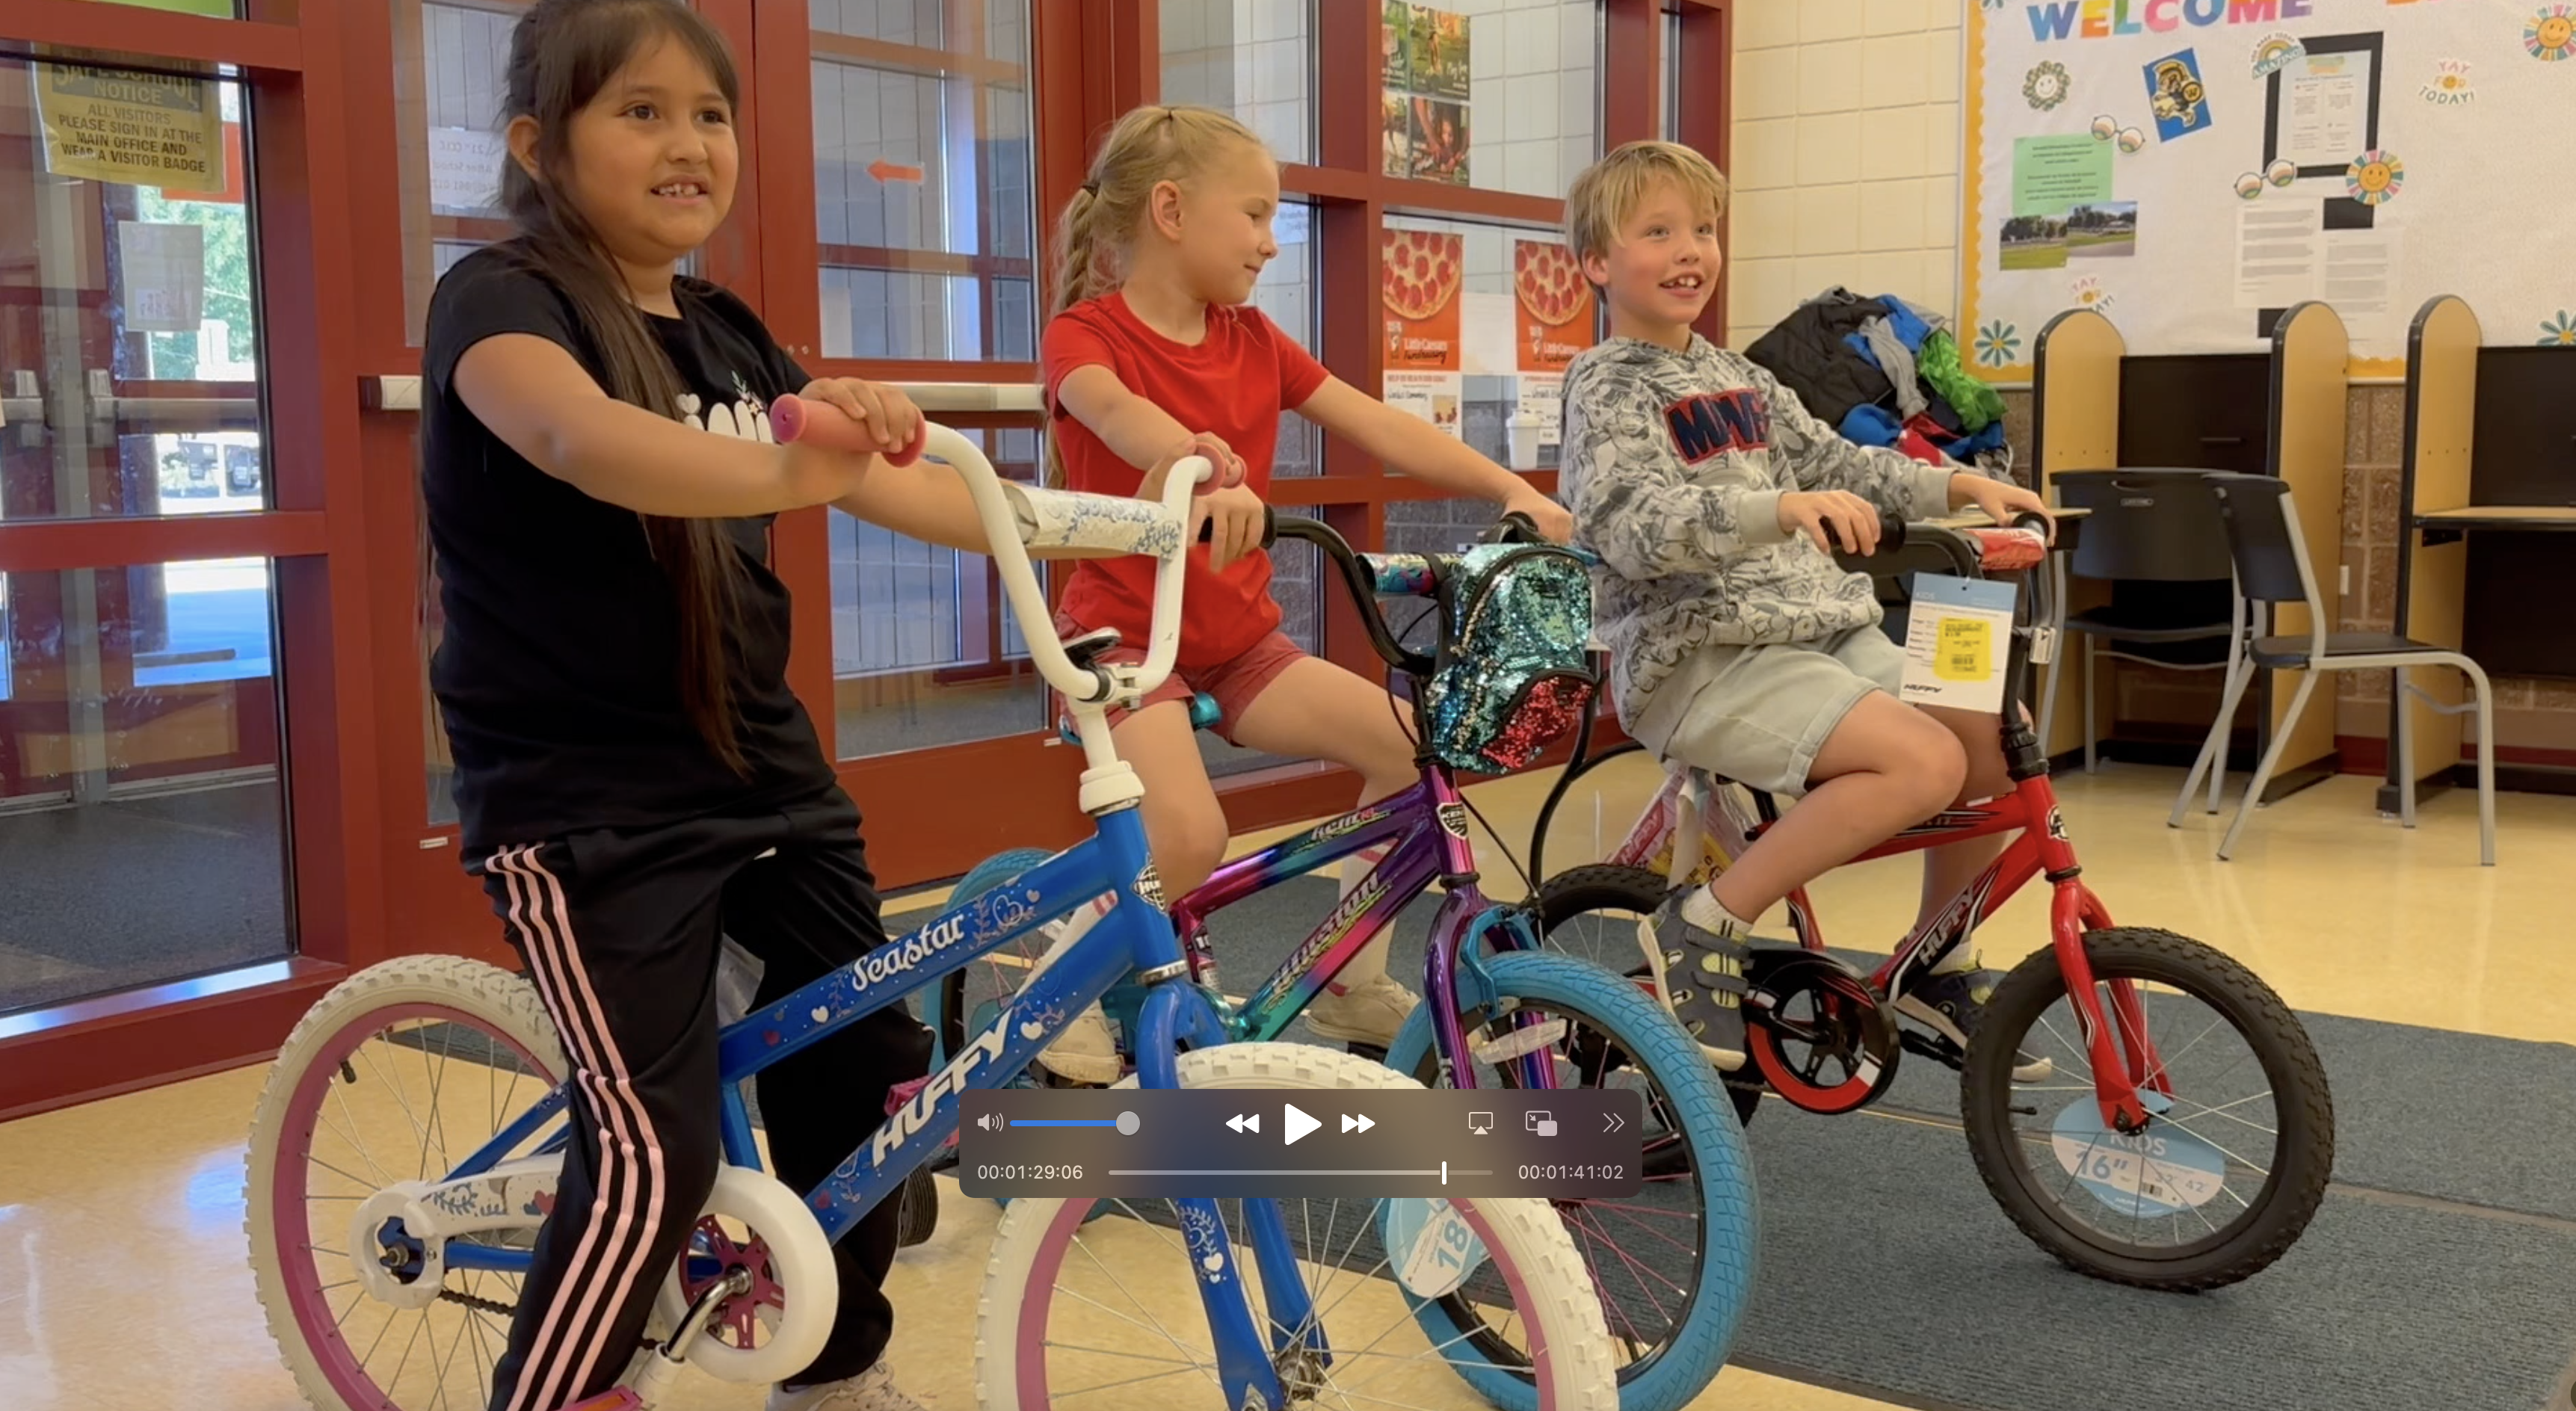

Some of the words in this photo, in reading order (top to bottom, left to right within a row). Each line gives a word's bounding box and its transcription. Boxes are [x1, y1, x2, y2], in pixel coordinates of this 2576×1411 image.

[2438, 61, 2471, 74] YAY
[94, 80, 163, 105] NOTICE
[2419, 86, 2475, 105] TODAY!
[87, 103, 108, 117] ALL
[114, 107, 171, 126] VISITORS
[58, 114, 106, 132] PLEASE
[109, 121, 140, 137] SIGN
[145, 126, 158, 138] IN
[162, 129, 176, 141] AT
[177, 130, 202, 144] THE
[76, 132, 109, 146] MAIN
[114, 137, 158, 152] OFFICE
[161, 142, 186, 156] AND
[98, 149, 106, 161] A
[111, 149, 159, 167] VISITOR
[164, 157, 206, 173] BADGE
[1918, 886, 1973, 966] HUFFY
[852, 913, 964, 992] Seastar
[872, 1006, 1014, 1168] HUFFY
